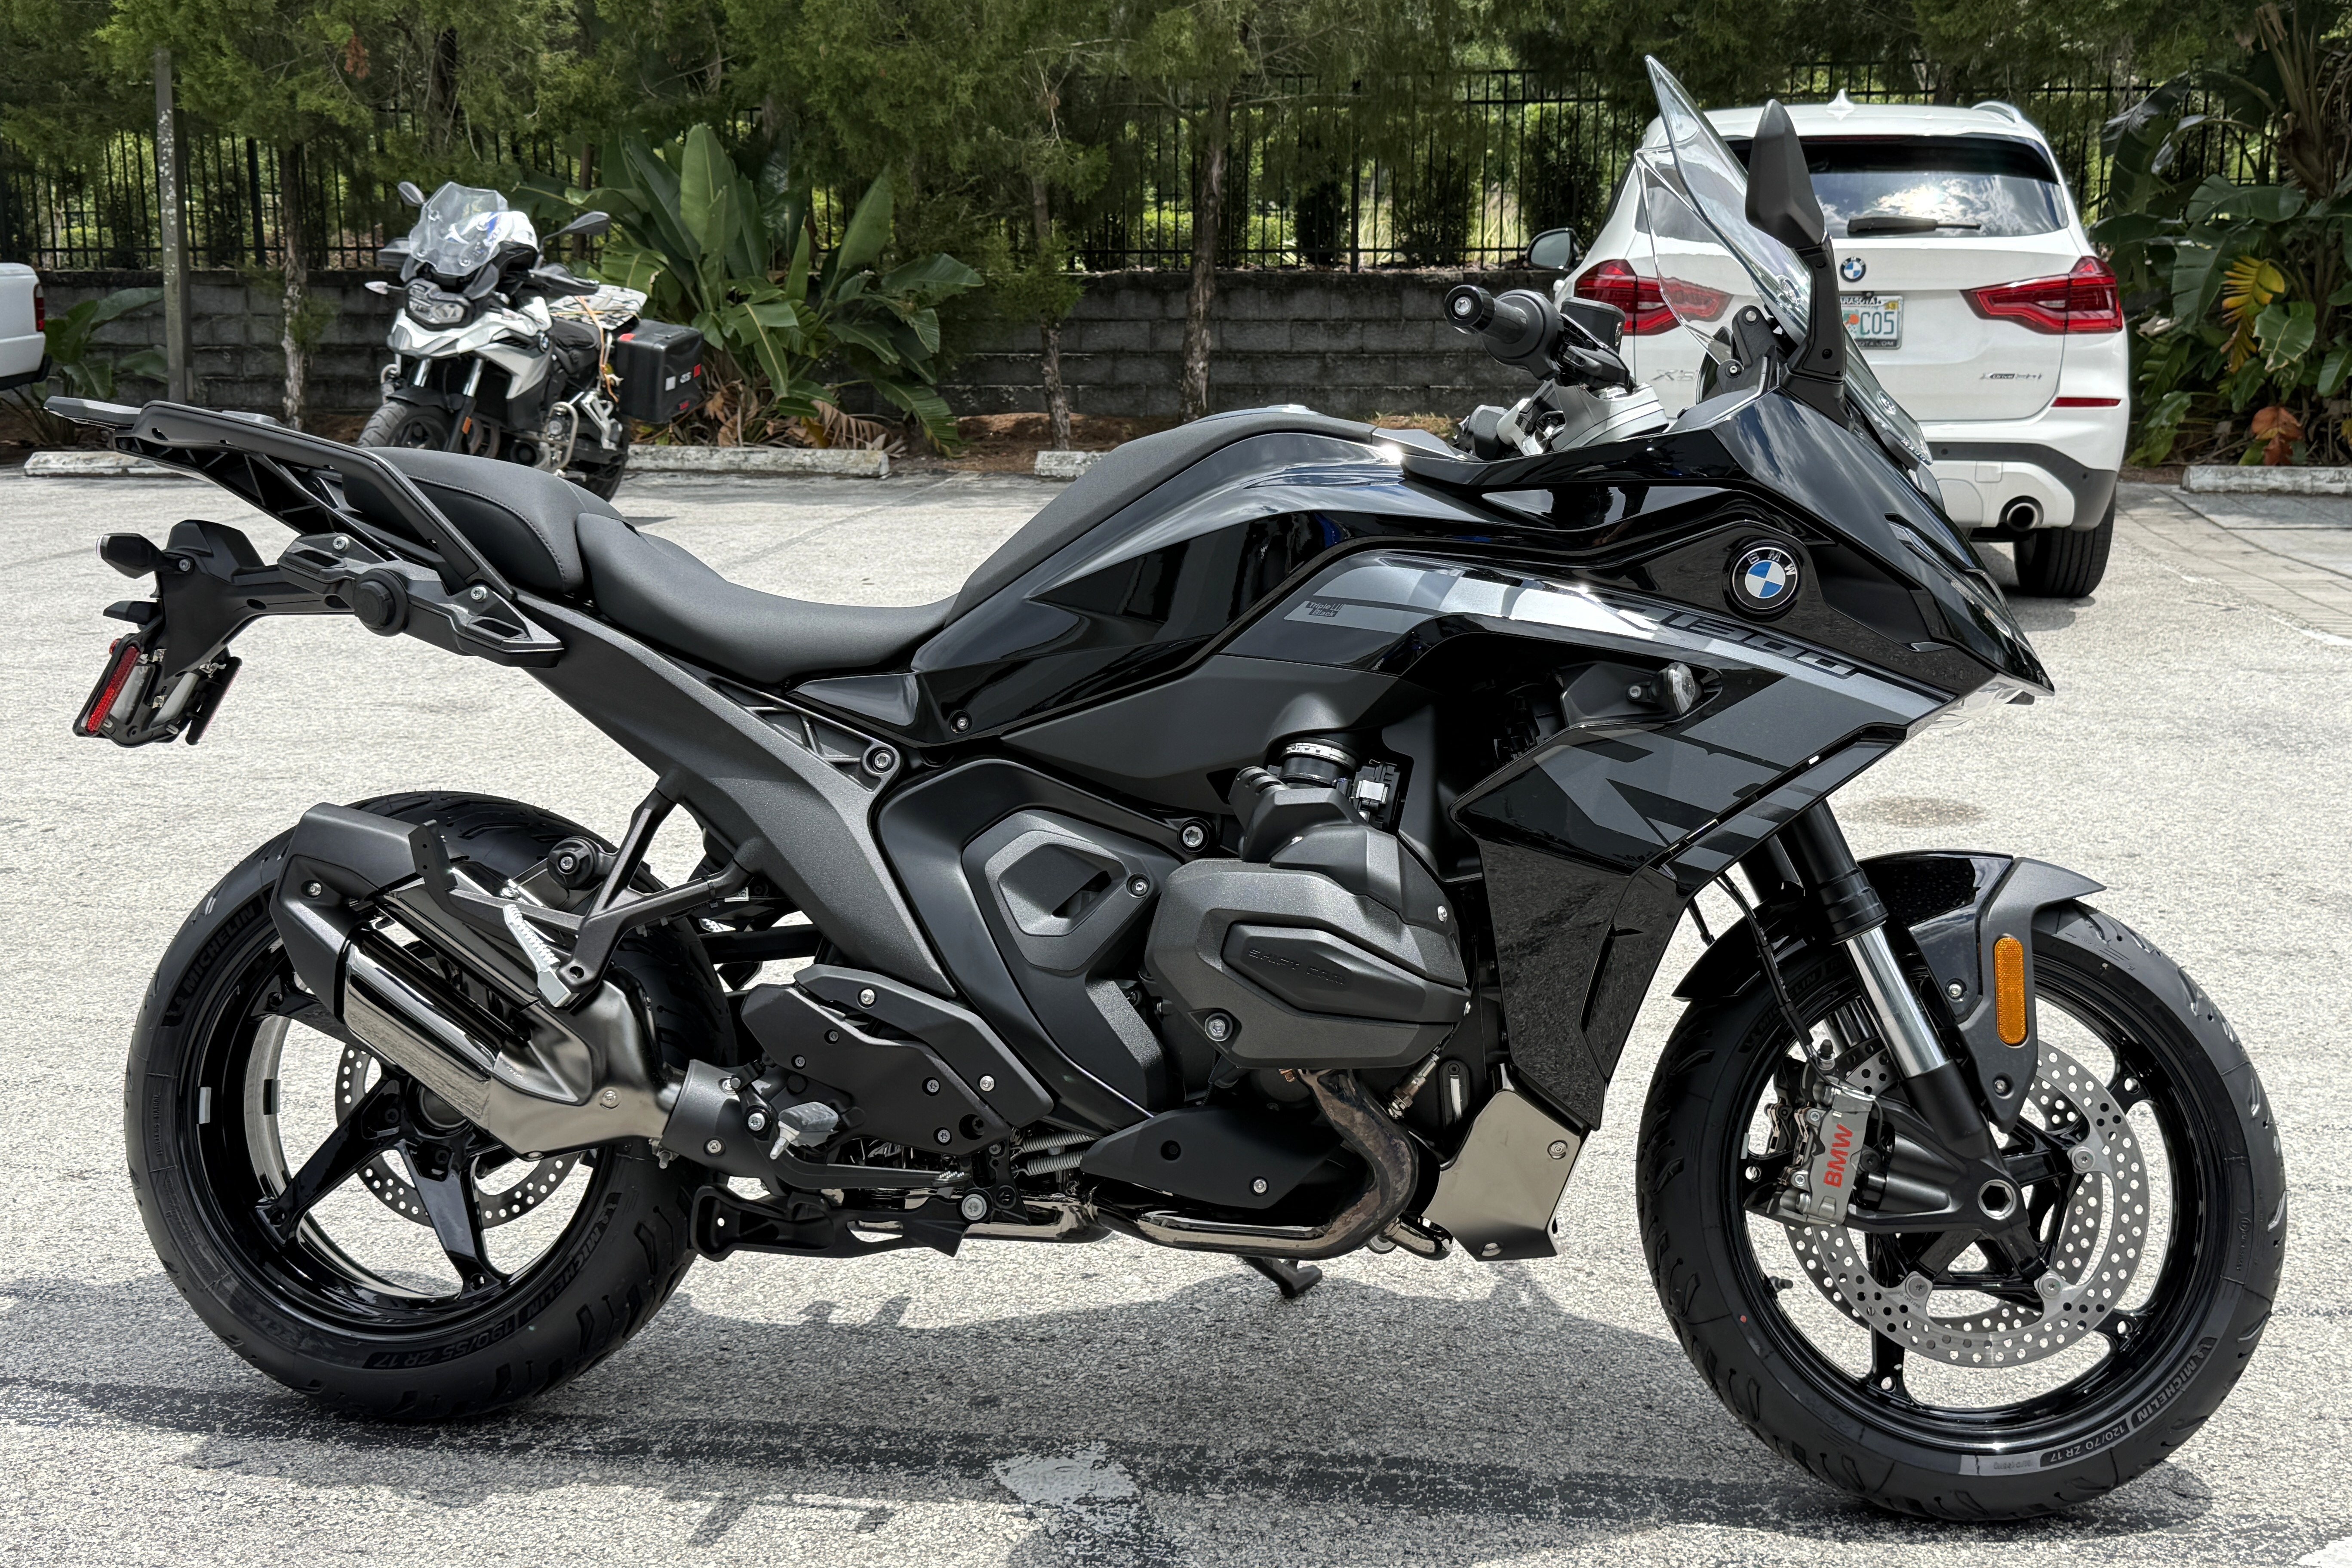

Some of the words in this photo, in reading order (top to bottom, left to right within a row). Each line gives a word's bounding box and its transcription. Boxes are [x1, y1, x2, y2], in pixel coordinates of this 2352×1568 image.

[1747, 550, 1796, 575] BMW
[1309, 602, 1331, 610] Triple
[182, 904, 256, 994] MICHELIN
[1823, 1123, 1854, 1188] BMW
[526, 1223, 601, 1319] MICHELIN
[439, 1320, 513, 1361] 190/55
[372, 1353, 400, 1368] 17
[403, 1350, 436, 1367] ZR
[2137, 1358, 2199, 1423] MICHELIN
[2085, 1425, 2125, 1451] 120/70
[2050, 1449, 2064, 1463] 17
[2066, 1444, 2083, 1459] ZR
